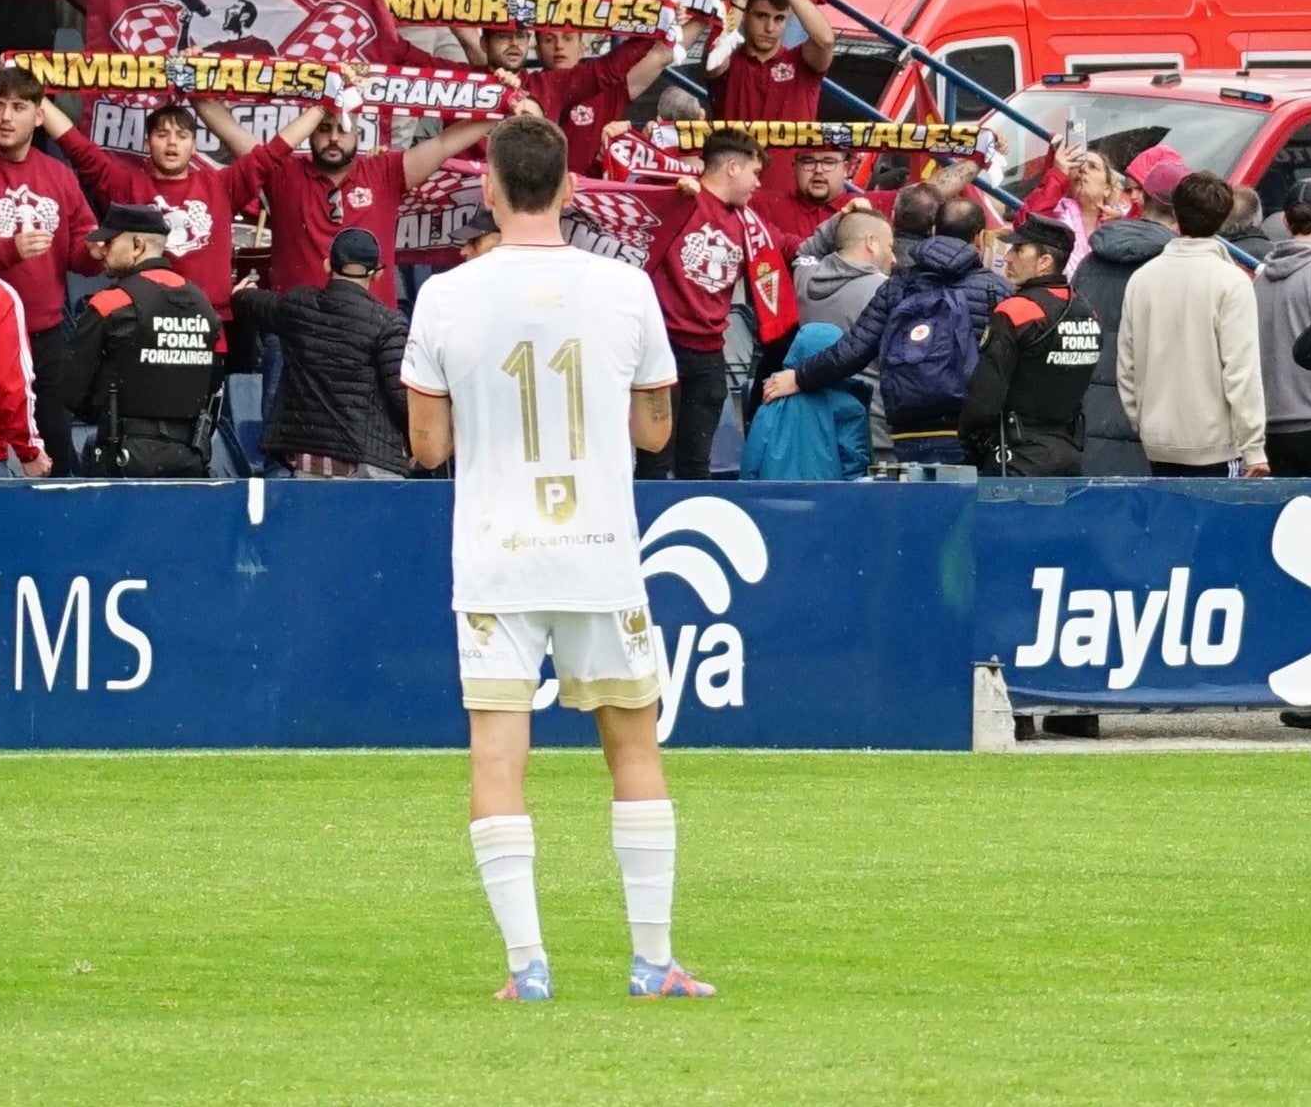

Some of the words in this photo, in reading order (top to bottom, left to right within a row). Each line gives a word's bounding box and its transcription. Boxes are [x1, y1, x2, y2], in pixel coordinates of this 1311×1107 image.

[365, 75, 503, 110] GRANAS
[153, 314, 211, 333] POLICÍA
[1057, 317, 1101, 334] POLICÍA
[157, 333, 207, 349] FORAL
[1062, 336, 1099, 350] FORAL
[501, 338, 586, 463] 11
[544, 483, 567, 514] P
[1015, 566, 1245, 690] Jaylo
